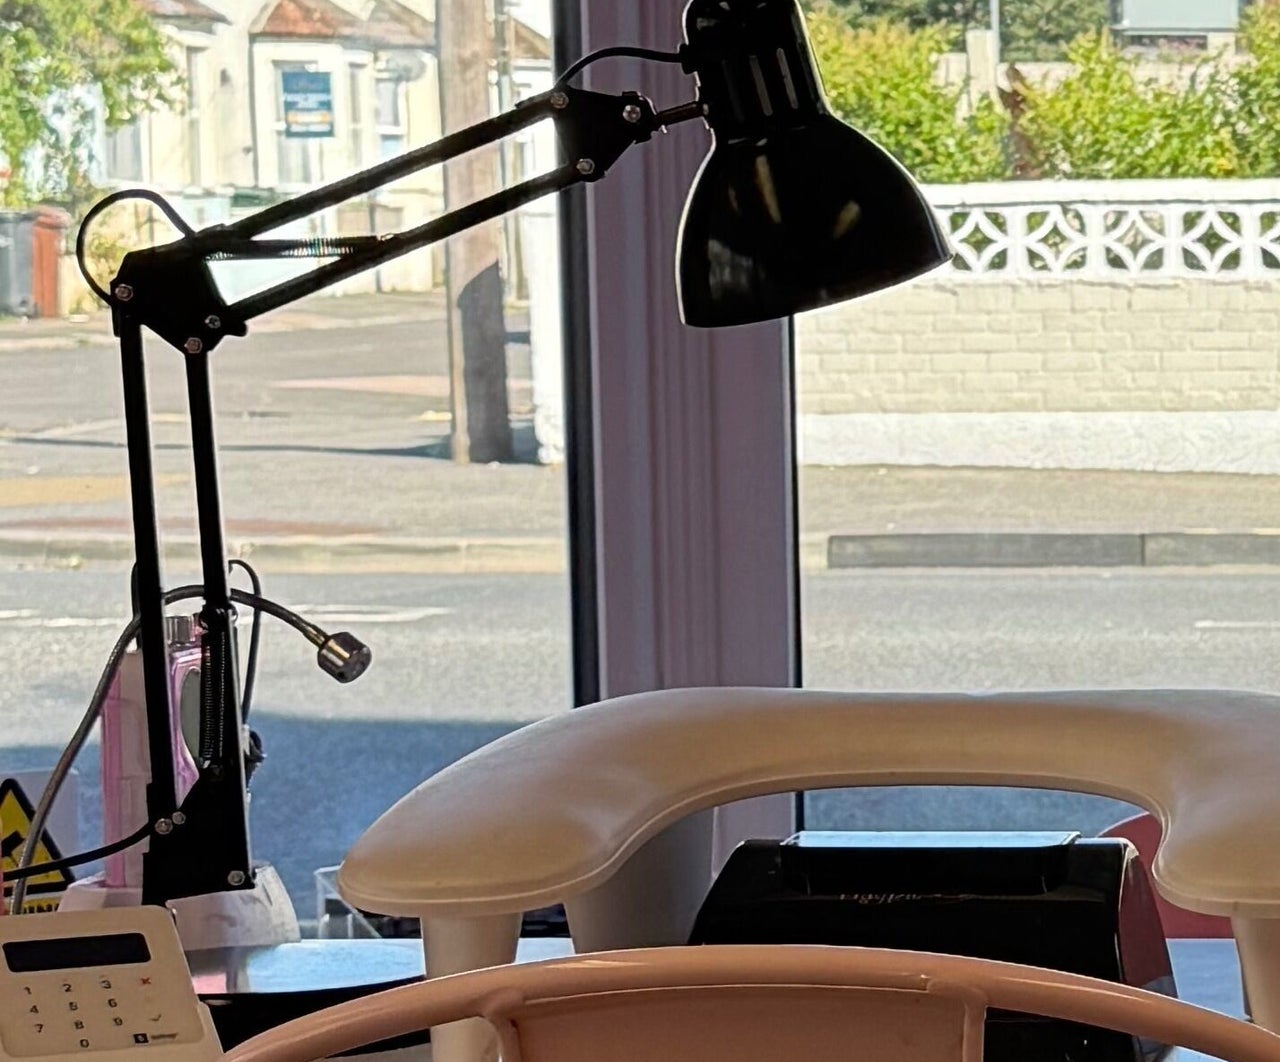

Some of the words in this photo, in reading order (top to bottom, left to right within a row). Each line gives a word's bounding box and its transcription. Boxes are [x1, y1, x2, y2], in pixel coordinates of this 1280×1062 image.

[24, 986, 32, 995] 1
[63, 983, 72, 992] 2
[101, 980, 112, 989] 3
[30, 1005, 39, 1014] 4
[69, 1002, 78, 1011] 5
[108, 999, 118, 1008] 6
[35, 1024, 44, 1033] 7
[75, 1020, 84, 1030] 8
[113, 1017, 123, 1026] 9
[80, 1039, 89, 1048] 0
